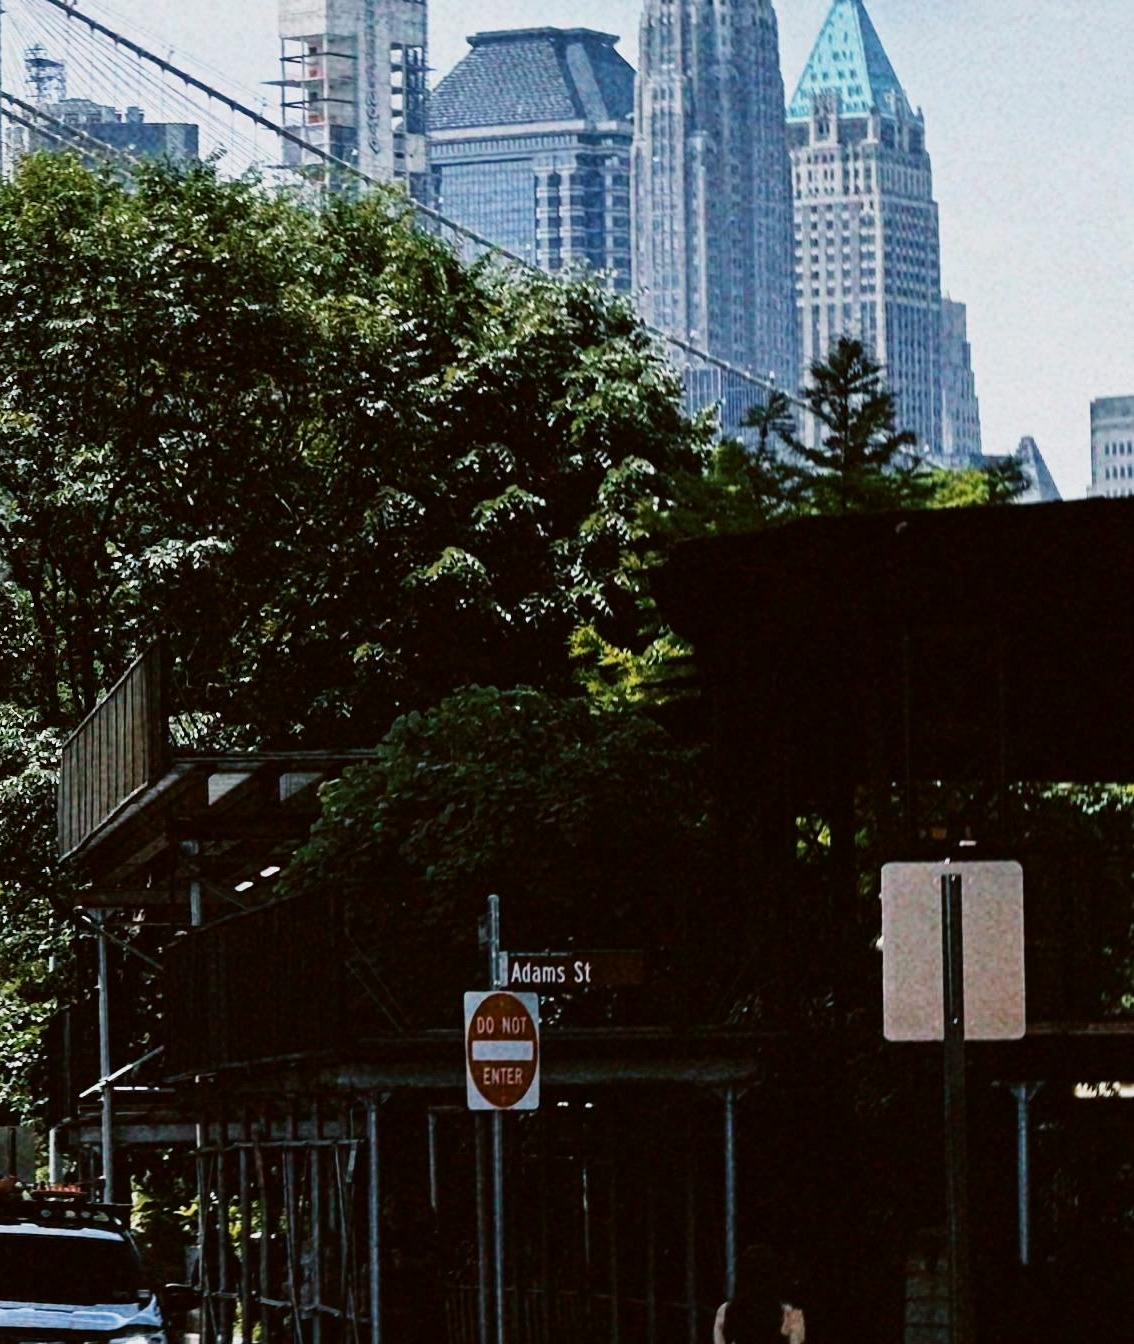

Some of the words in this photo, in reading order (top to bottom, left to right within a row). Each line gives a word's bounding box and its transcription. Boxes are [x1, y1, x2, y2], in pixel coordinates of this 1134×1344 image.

[511, 961, 566, 984] Adams
[574, 960, 592, 984] St
[476, 1016, 495, 1035] DO
[501, 1016, 527, 1035] NOT
[482, 1067, 524, 1086] ENTER
